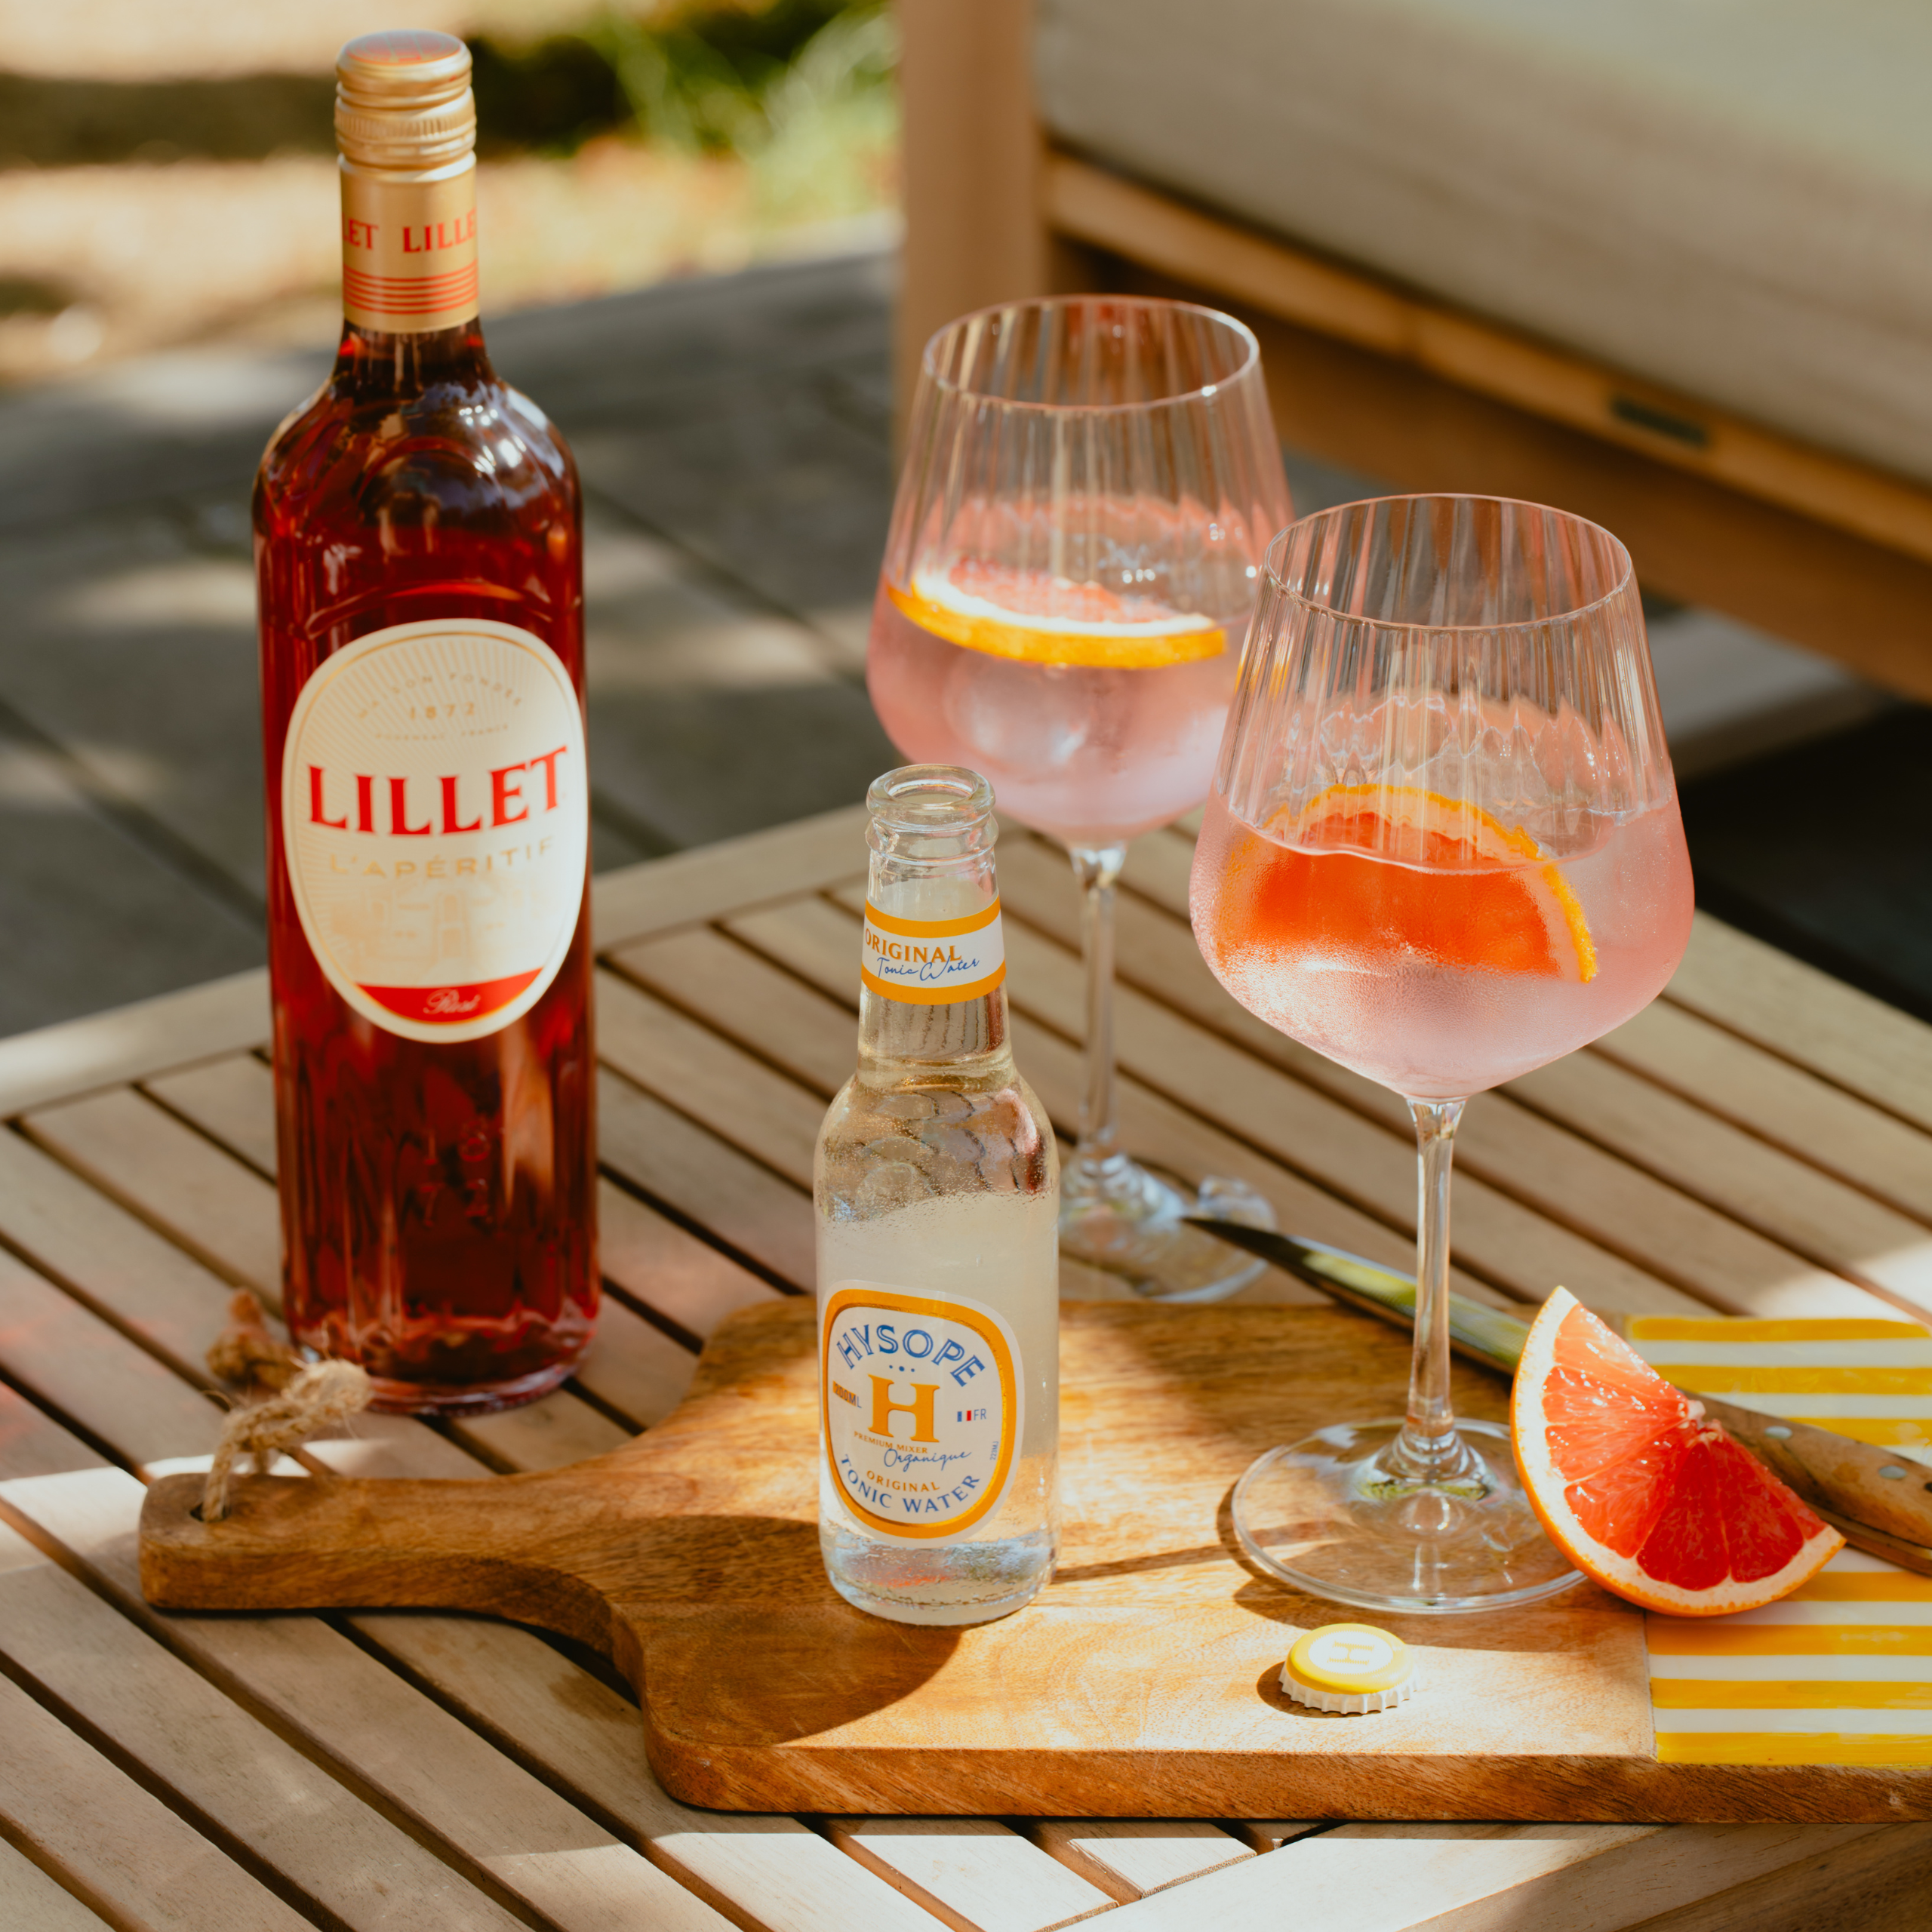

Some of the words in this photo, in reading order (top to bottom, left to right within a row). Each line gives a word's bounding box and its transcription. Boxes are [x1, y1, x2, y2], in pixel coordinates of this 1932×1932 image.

[307, 745, 568, 835] LILLET
[330, 836, 553, 878] L'APÉRITIF
[865, 928, 962, 964] ORIGINAL
[877, 957, 918, 978] Tonic
[919, 955, 980, 981] Water
[836, 1324, 986, 1387] HYSOPE
[868, 1374, 940, 1443] H
[974, 1408, 986, 1420] FR
[854, 1431, 893, 1449] PREMIUM
[897, 1444, 928, 1454] MIXER
[884, 1448, 972, 1472] Organique
[841, 1454, 892, 1509] TONIC
[903, 1475, 980, 1513] WATER
[866, 1470, 940, 1492] ORIGINAL
